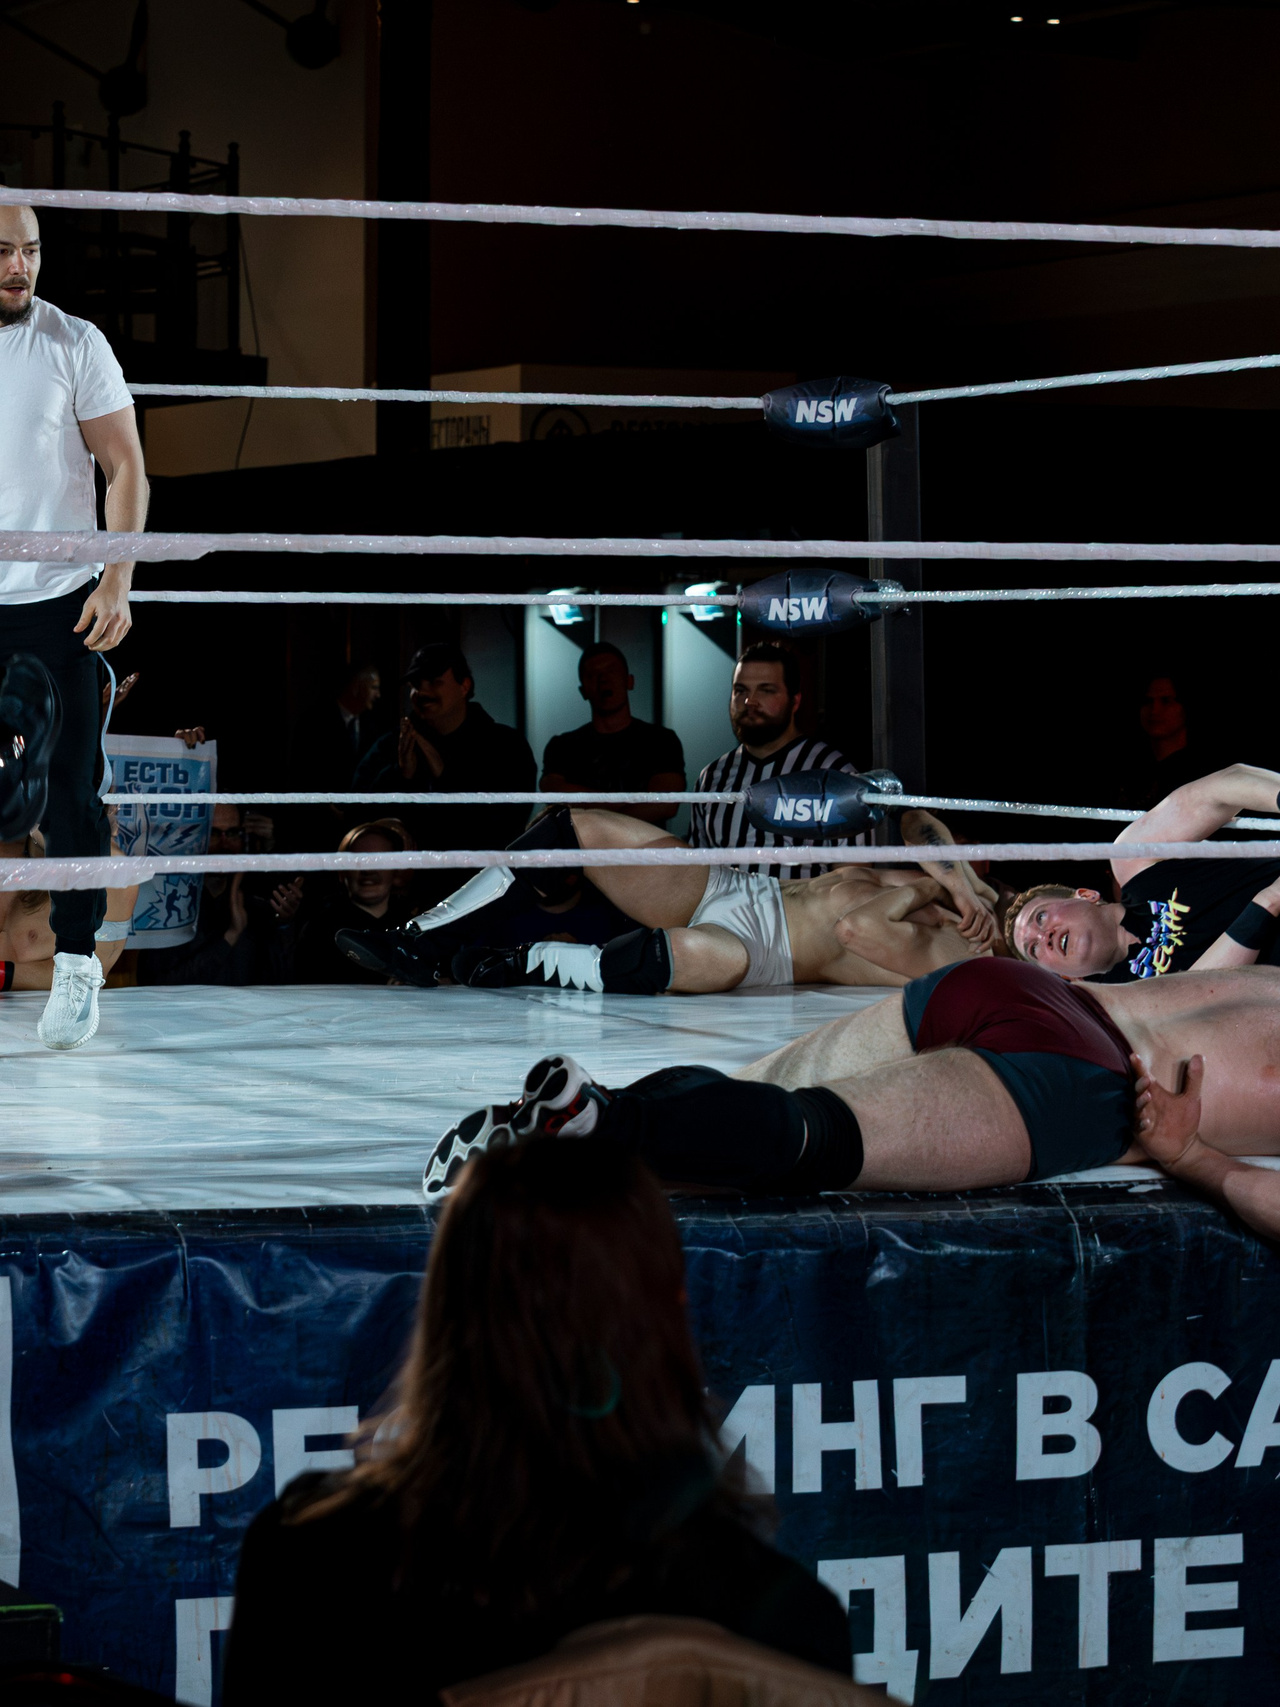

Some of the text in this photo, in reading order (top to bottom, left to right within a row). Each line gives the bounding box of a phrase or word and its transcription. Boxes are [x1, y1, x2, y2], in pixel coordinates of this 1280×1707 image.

[795, 398, 858, 423] NSW
[768, 596, 828, 621] NSW
[124, 761, 189, 784] ЕСТЬ
[773, 797, 834, 822] NSW
[1015, 1369, 1103, 1481] В
